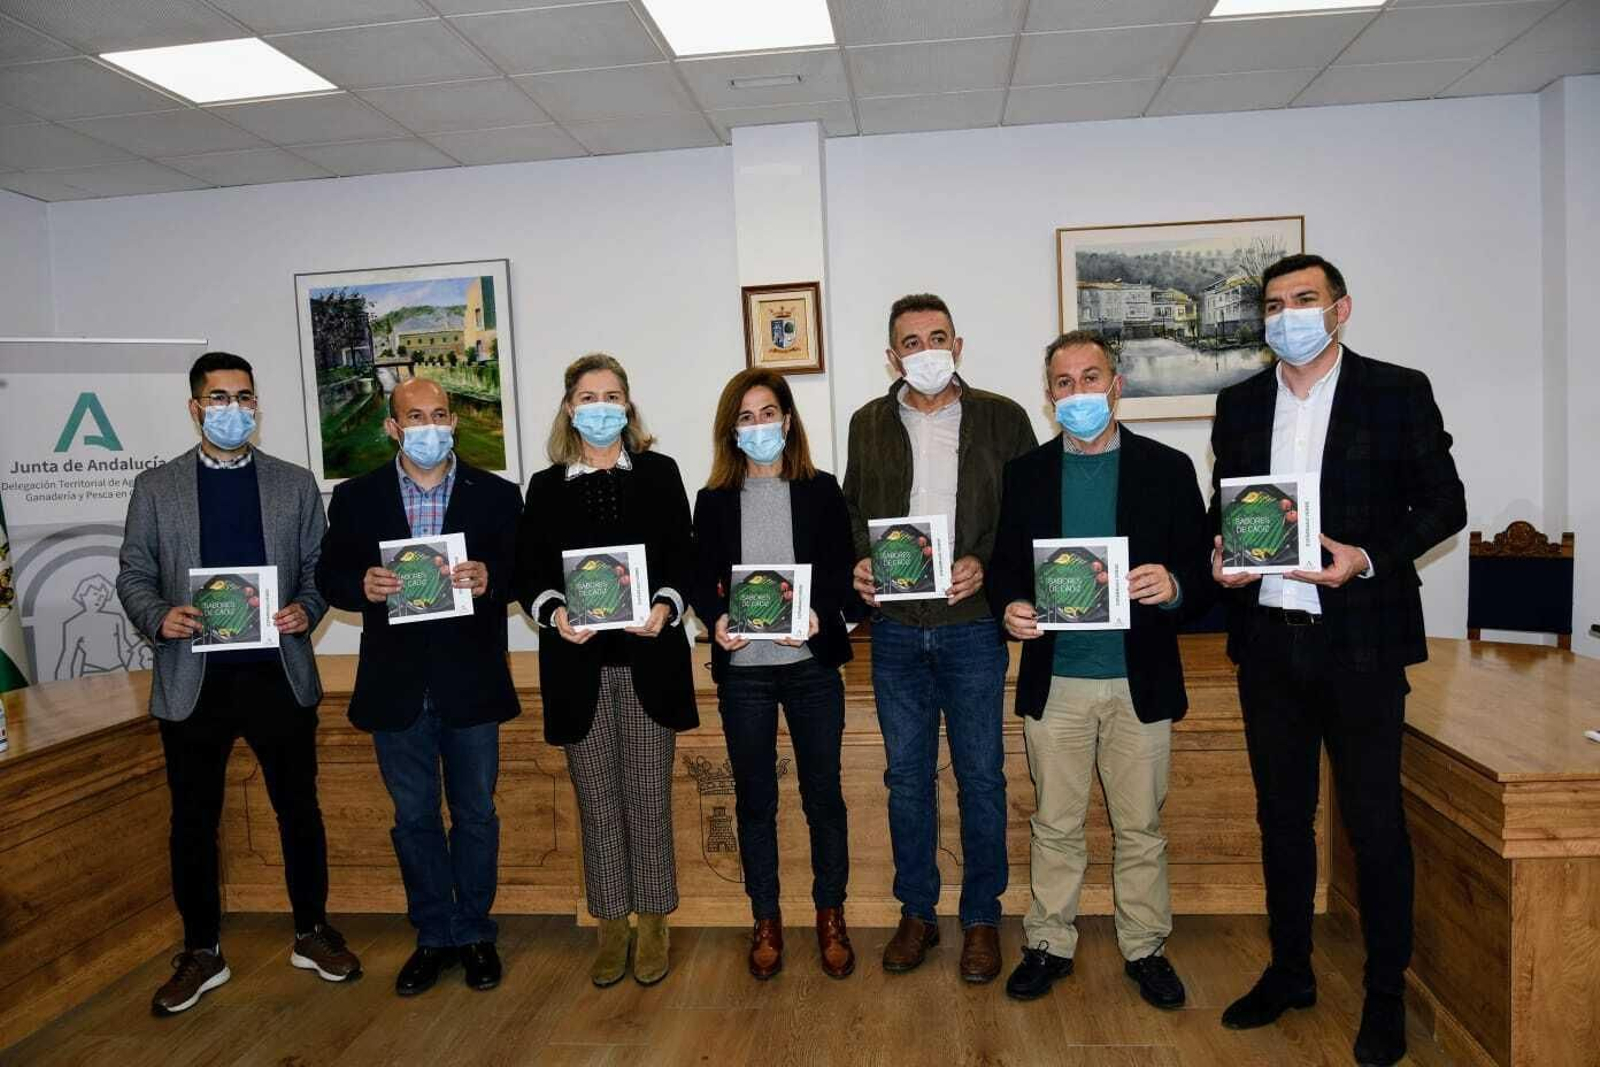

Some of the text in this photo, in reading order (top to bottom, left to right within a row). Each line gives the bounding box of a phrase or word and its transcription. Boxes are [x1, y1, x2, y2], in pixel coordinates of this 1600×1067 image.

[10, 461, 58, 474] Junta
[63, 460, 83, 472] de
[2, 480, 55, 491] Delegación
[60, 478, 106, 489] Territorial
[109, 478, 120, 487] de
[26, 491, 76, 502] Ganadería
[86, 490, 113, 499] Pesca
[115, 489, 127, 498] en
